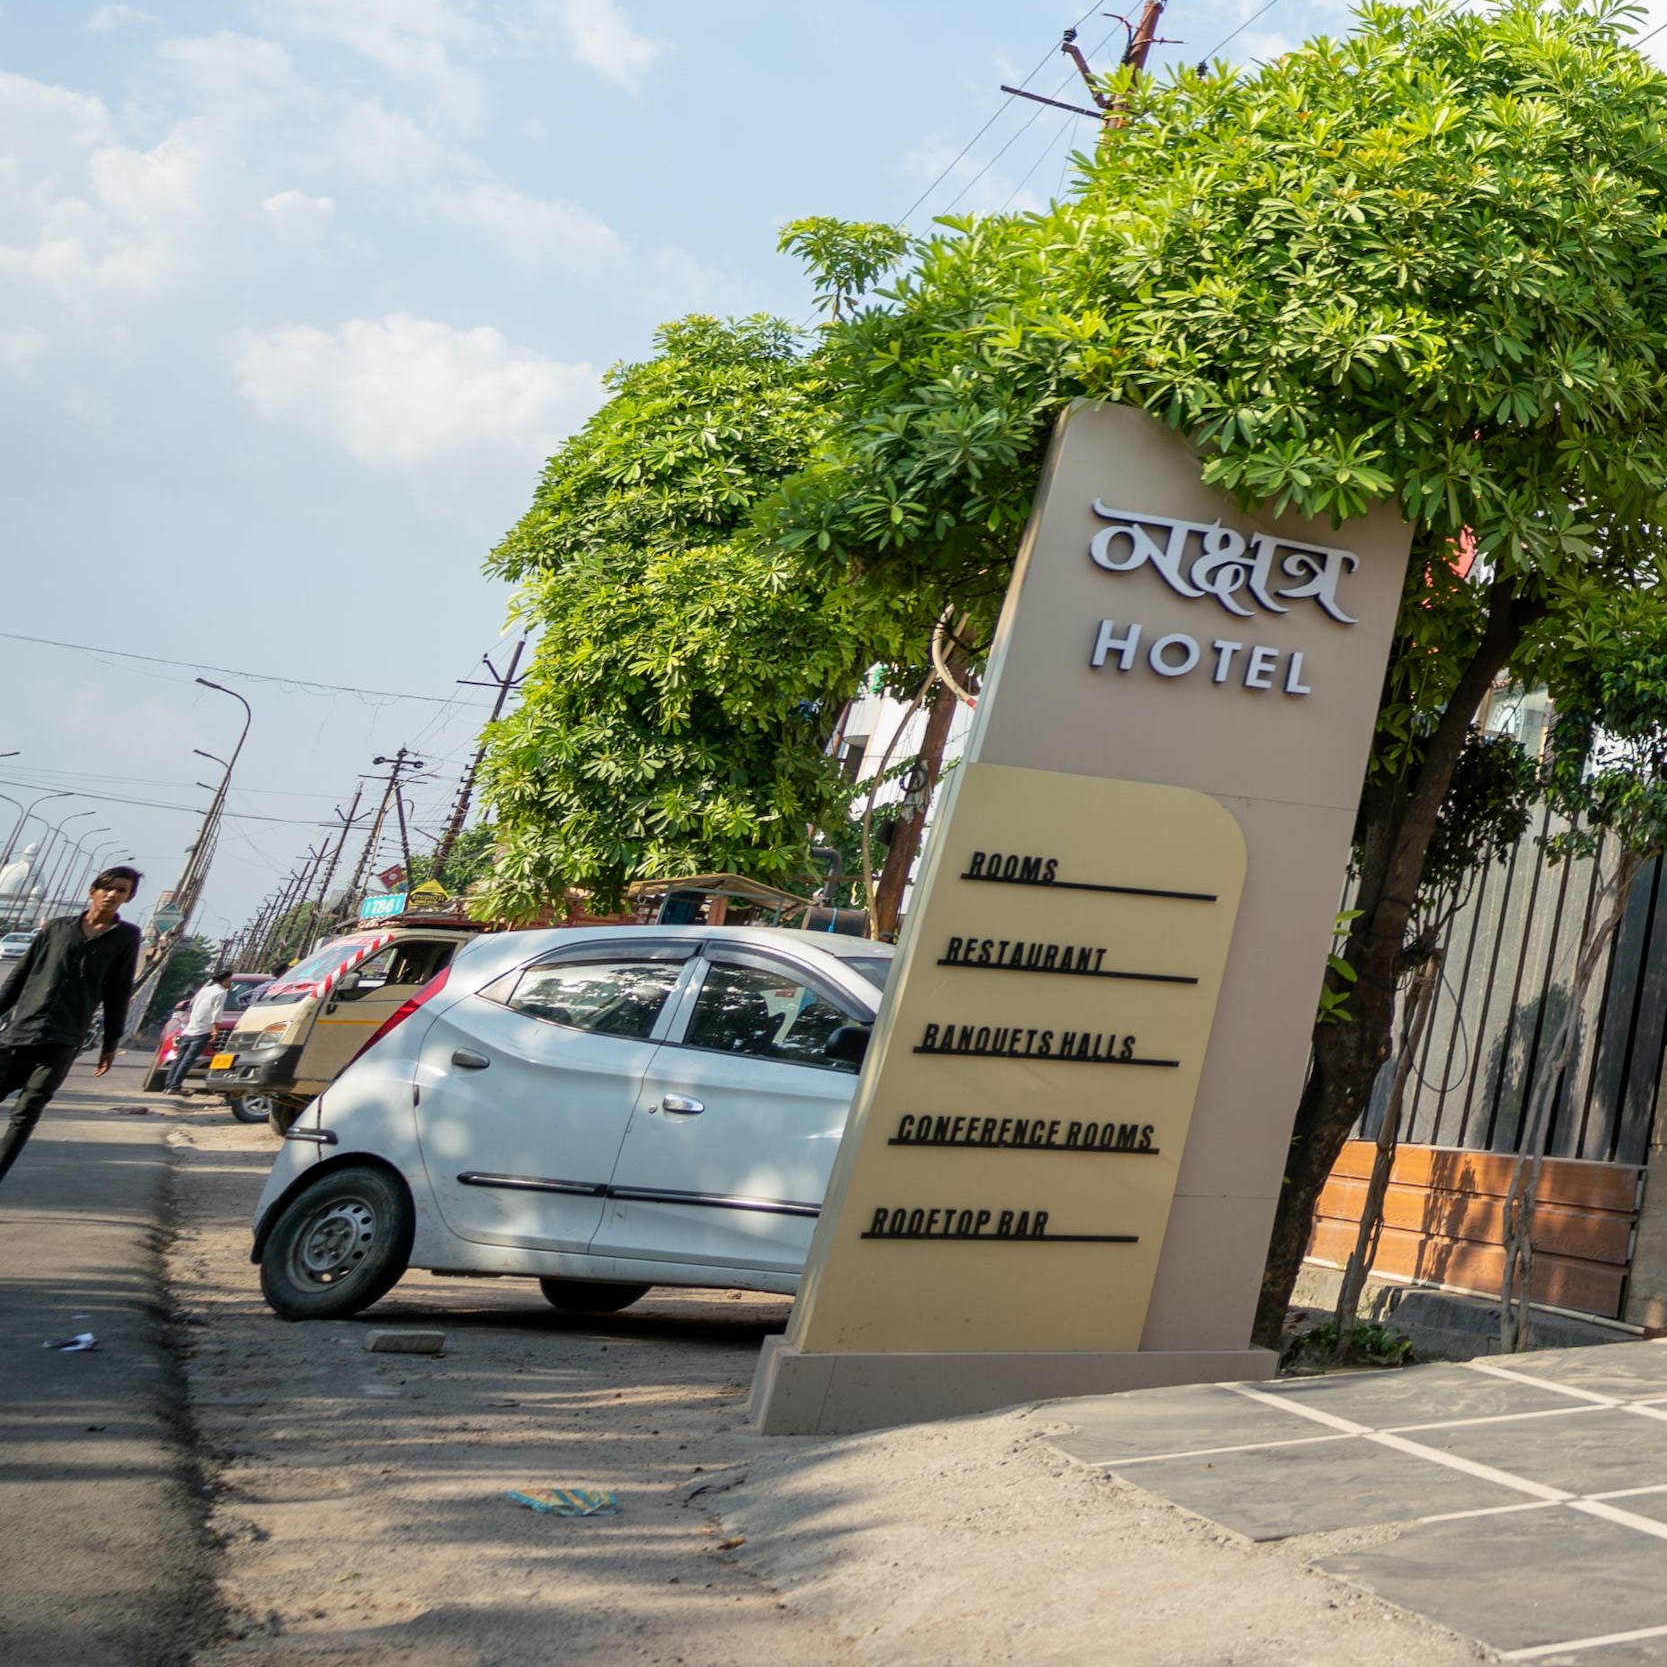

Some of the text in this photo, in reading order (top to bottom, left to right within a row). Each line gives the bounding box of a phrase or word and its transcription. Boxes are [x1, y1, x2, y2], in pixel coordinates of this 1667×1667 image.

[1089, 496, 1360, 624] नक्षत्र
[1090, 618, 1311, 695] HOTEL
[969, 851, 1059, 883] ROOMS
[945, 936, 1107, 973] RESTAURANT
[922, 1023, 1136, 1061] BANQUETS HALLS
[898, 1114, 1155, 1150] CONFERENCE ROOMS
[871, 1207, 1049, 1237] ROOFTOP BAR
